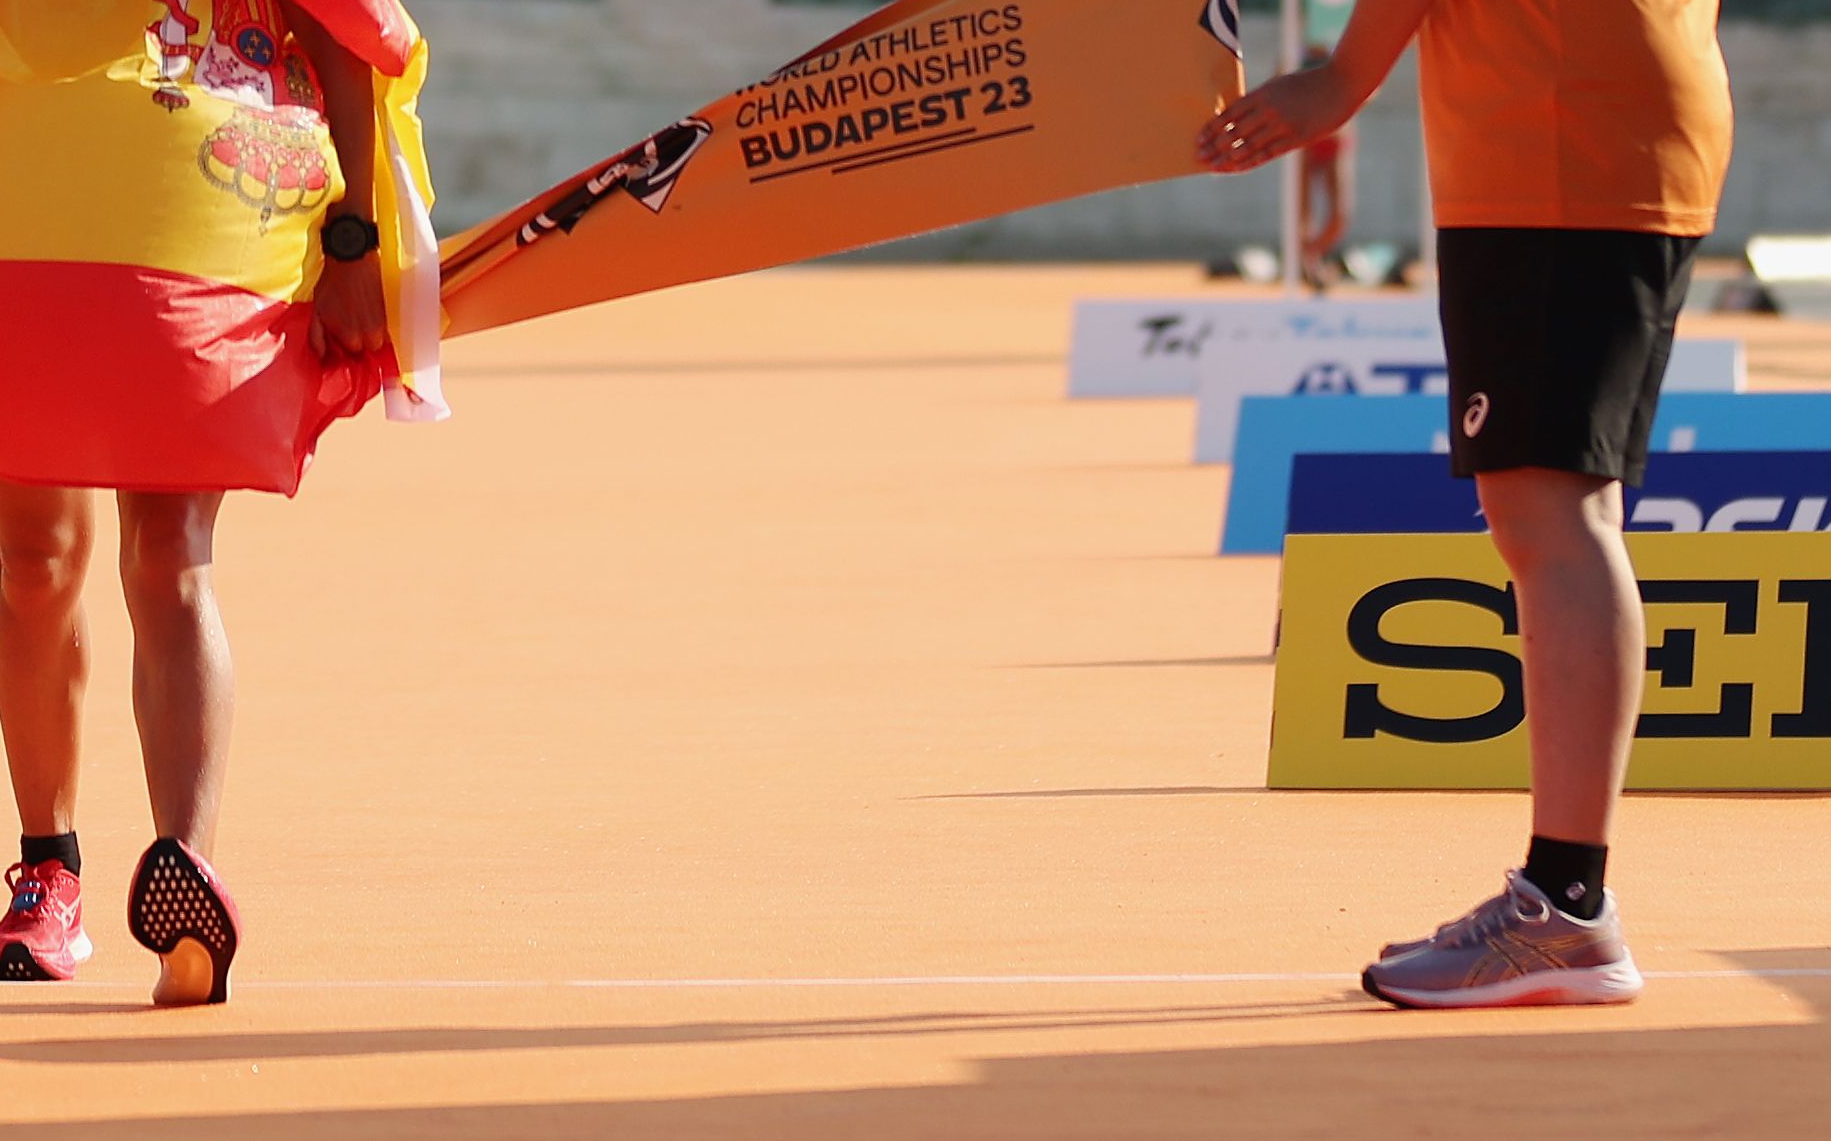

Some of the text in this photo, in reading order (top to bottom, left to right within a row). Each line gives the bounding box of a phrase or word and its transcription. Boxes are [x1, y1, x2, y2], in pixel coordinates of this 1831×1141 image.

[735, 5, 1022, 97] RLD ATHLETICS
[736, 39, 1027, 128] CHAMPIONSHIPS
[740, 76, 1032, 169] BUDAPEST 23
